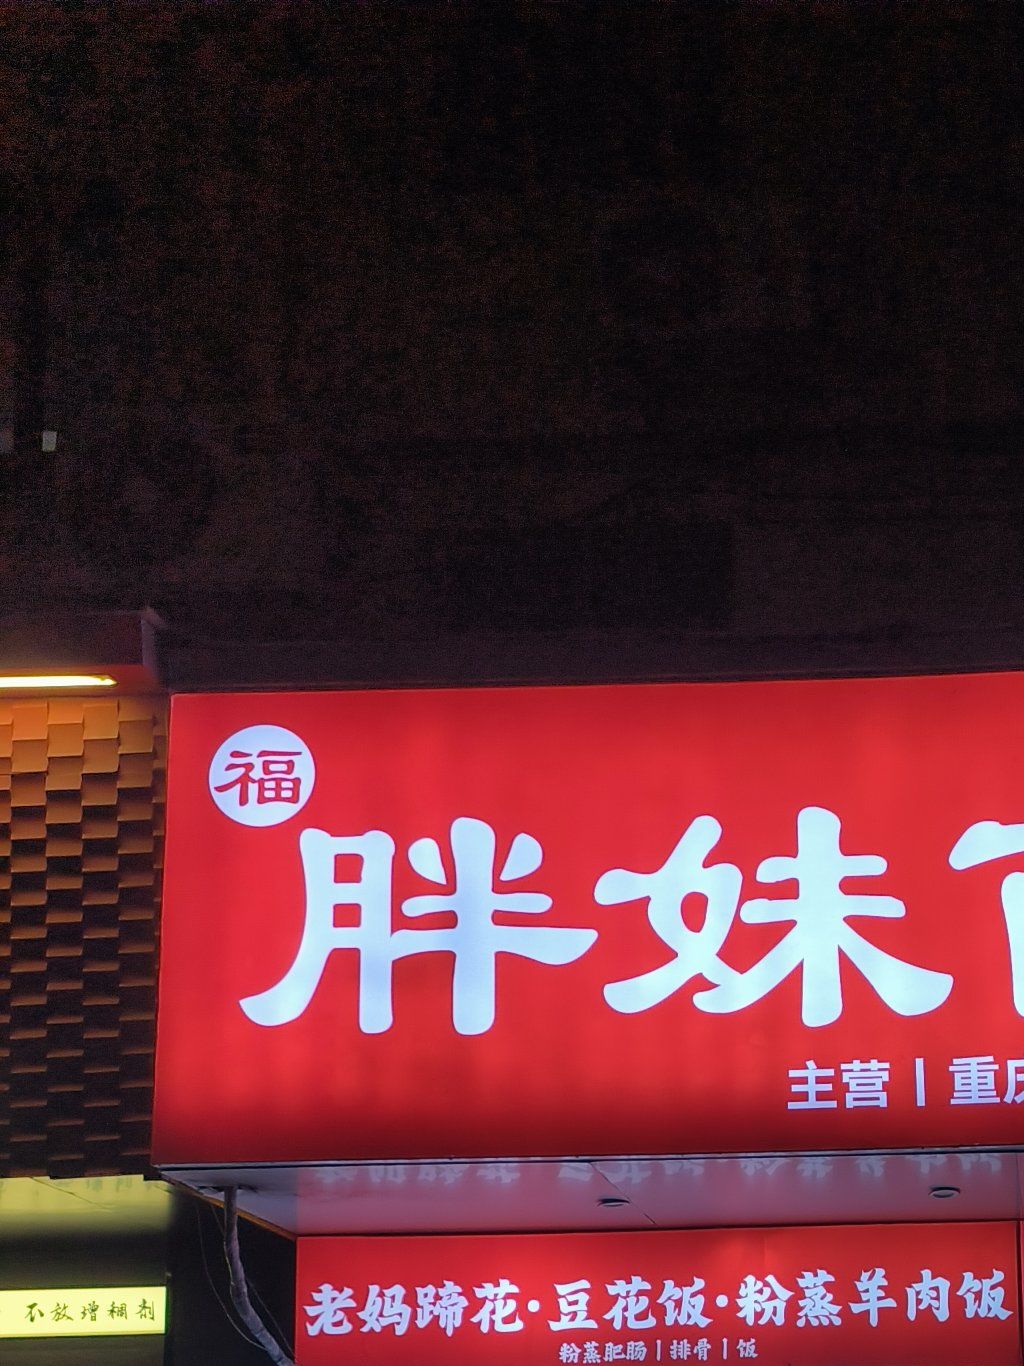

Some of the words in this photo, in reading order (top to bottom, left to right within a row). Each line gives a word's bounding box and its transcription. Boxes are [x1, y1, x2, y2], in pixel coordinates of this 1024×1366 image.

[214, 749, 303, 807] 福
[787, 1059, 890, 1109] 主营
[559, 1340, 648, 1364] 粉蒸肥肠
[669, 1338, 712, 1362] 排骨
[736, 1339, 759, 1360] 饭
